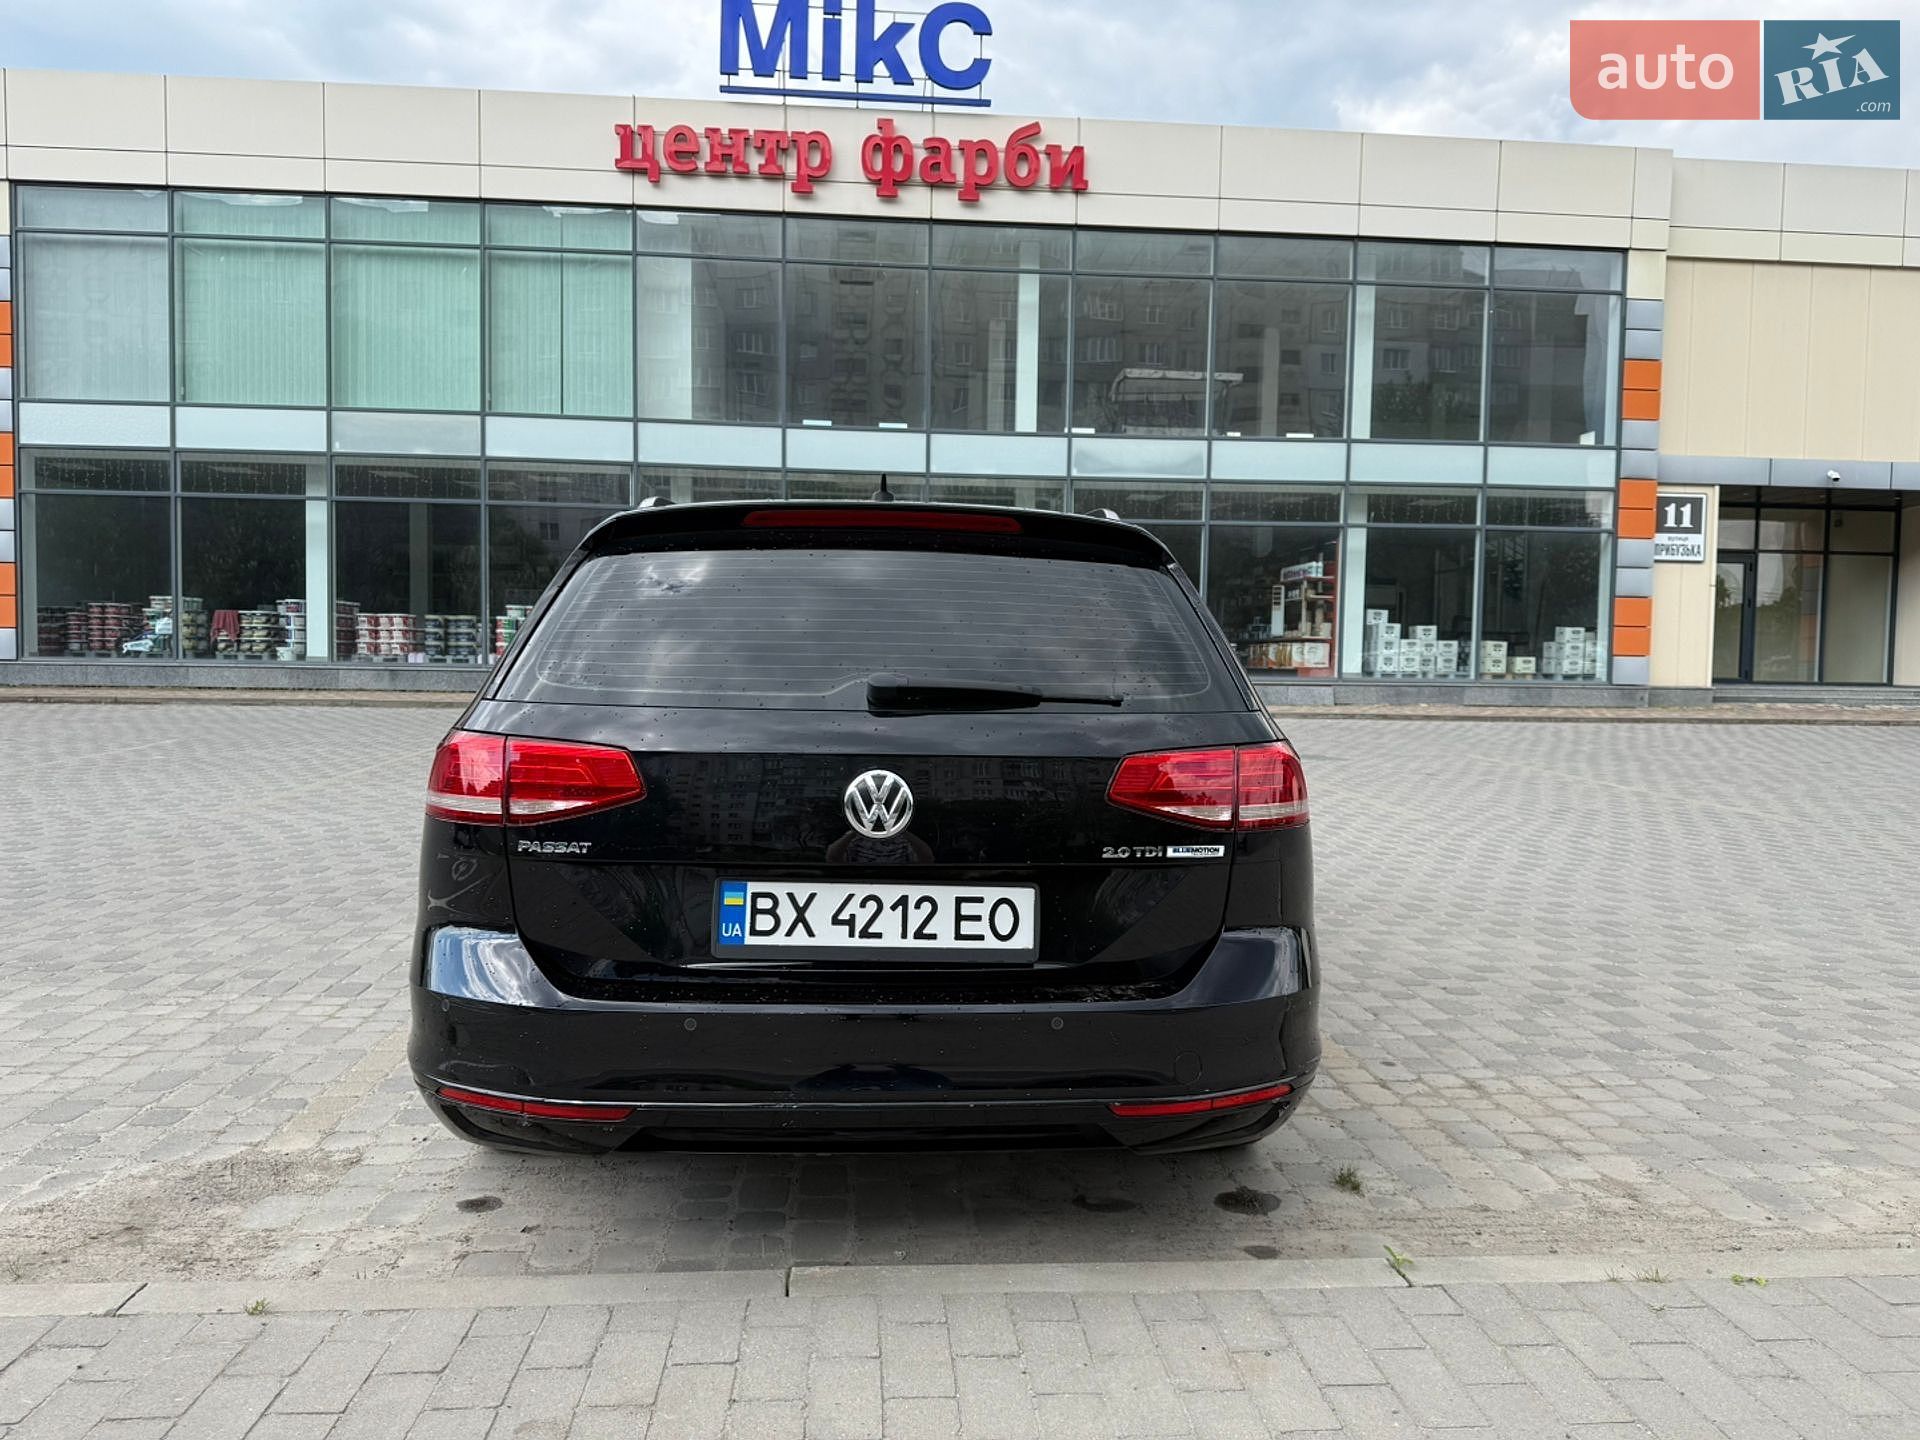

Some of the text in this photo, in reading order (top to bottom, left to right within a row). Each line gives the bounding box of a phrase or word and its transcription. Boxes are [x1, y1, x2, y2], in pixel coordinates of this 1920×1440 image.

[614, 118, 1089, 202] центр фарби
[1663, 502, 1695, 528] 11
[517, 840, 592, 853] PASSAT
[1102, 846, 1131, 858] 2.0
[749, 892, 817, 937] BX
[831, 893, 939, 940] 4212
[722, 923, 742, 937] UA
